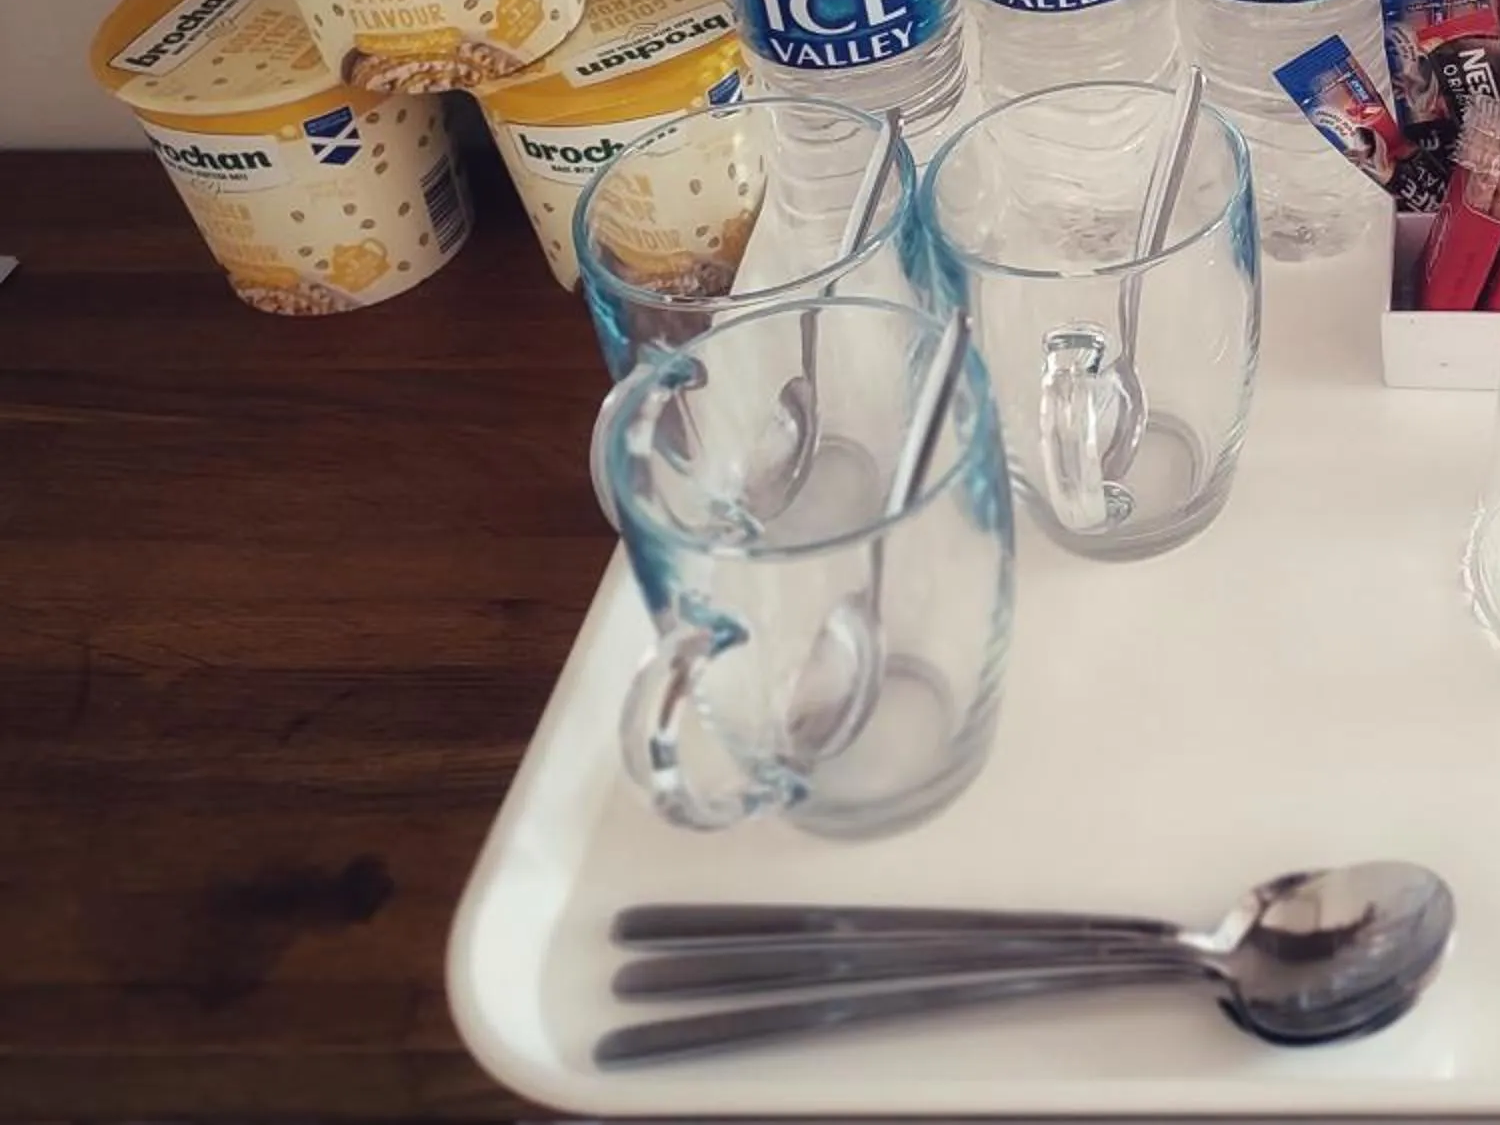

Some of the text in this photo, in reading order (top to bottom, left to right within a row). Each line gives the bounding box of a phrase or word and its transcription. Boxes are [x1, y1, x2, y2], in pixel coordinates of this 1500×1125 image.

[349, 2, 447, 31] FLAVOUR
[576, 14, 731, 76] brochan
[769, 20, 914, 68] VALLEY
